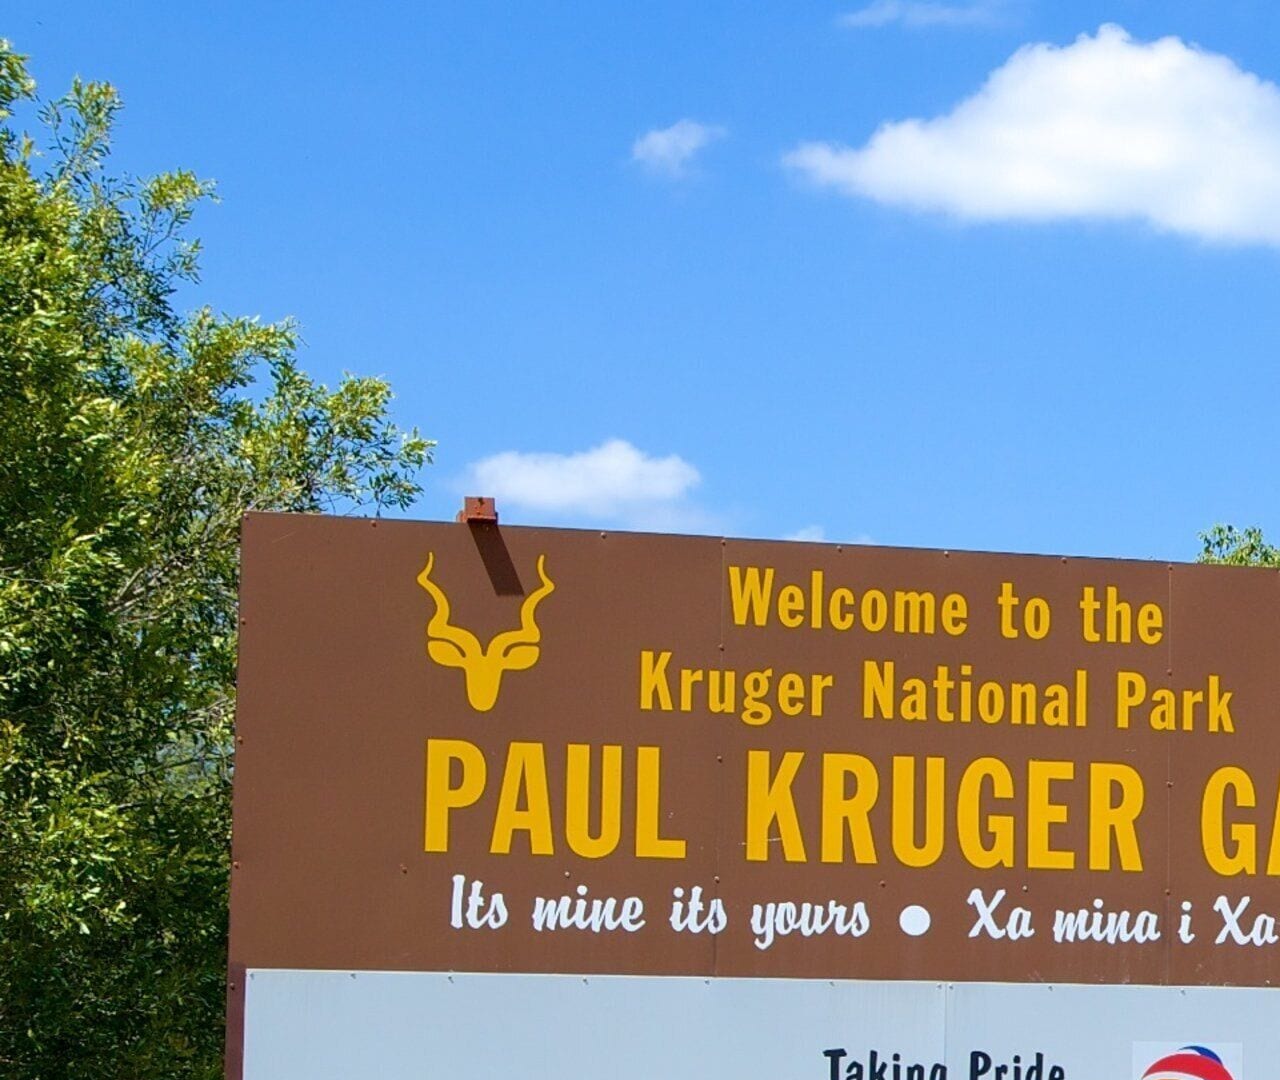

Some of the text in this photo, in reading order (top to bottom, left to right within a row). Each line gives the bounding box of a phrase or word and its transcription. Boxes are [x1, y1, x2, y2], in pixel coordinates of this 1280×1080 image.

[728, 565, 1164, 646] Welcome to the
[639, 650, 1234, 734] Kruger National Park
[423, 738, 687, 859] PAUL
[740, 749, 1146, 873] KRUGER
[450, 874, 509, 930] Its
[531, 885, 646, 933] mine
[668, 886, 728, 935] its
[750, 899, 870, 950] yours
[966, 888, 1035, 941] Xa
[1052, 898, 1161, 945] mina
[1177, 901, 1196, 944] i
[1213, 895, 1279, 947] Xa
